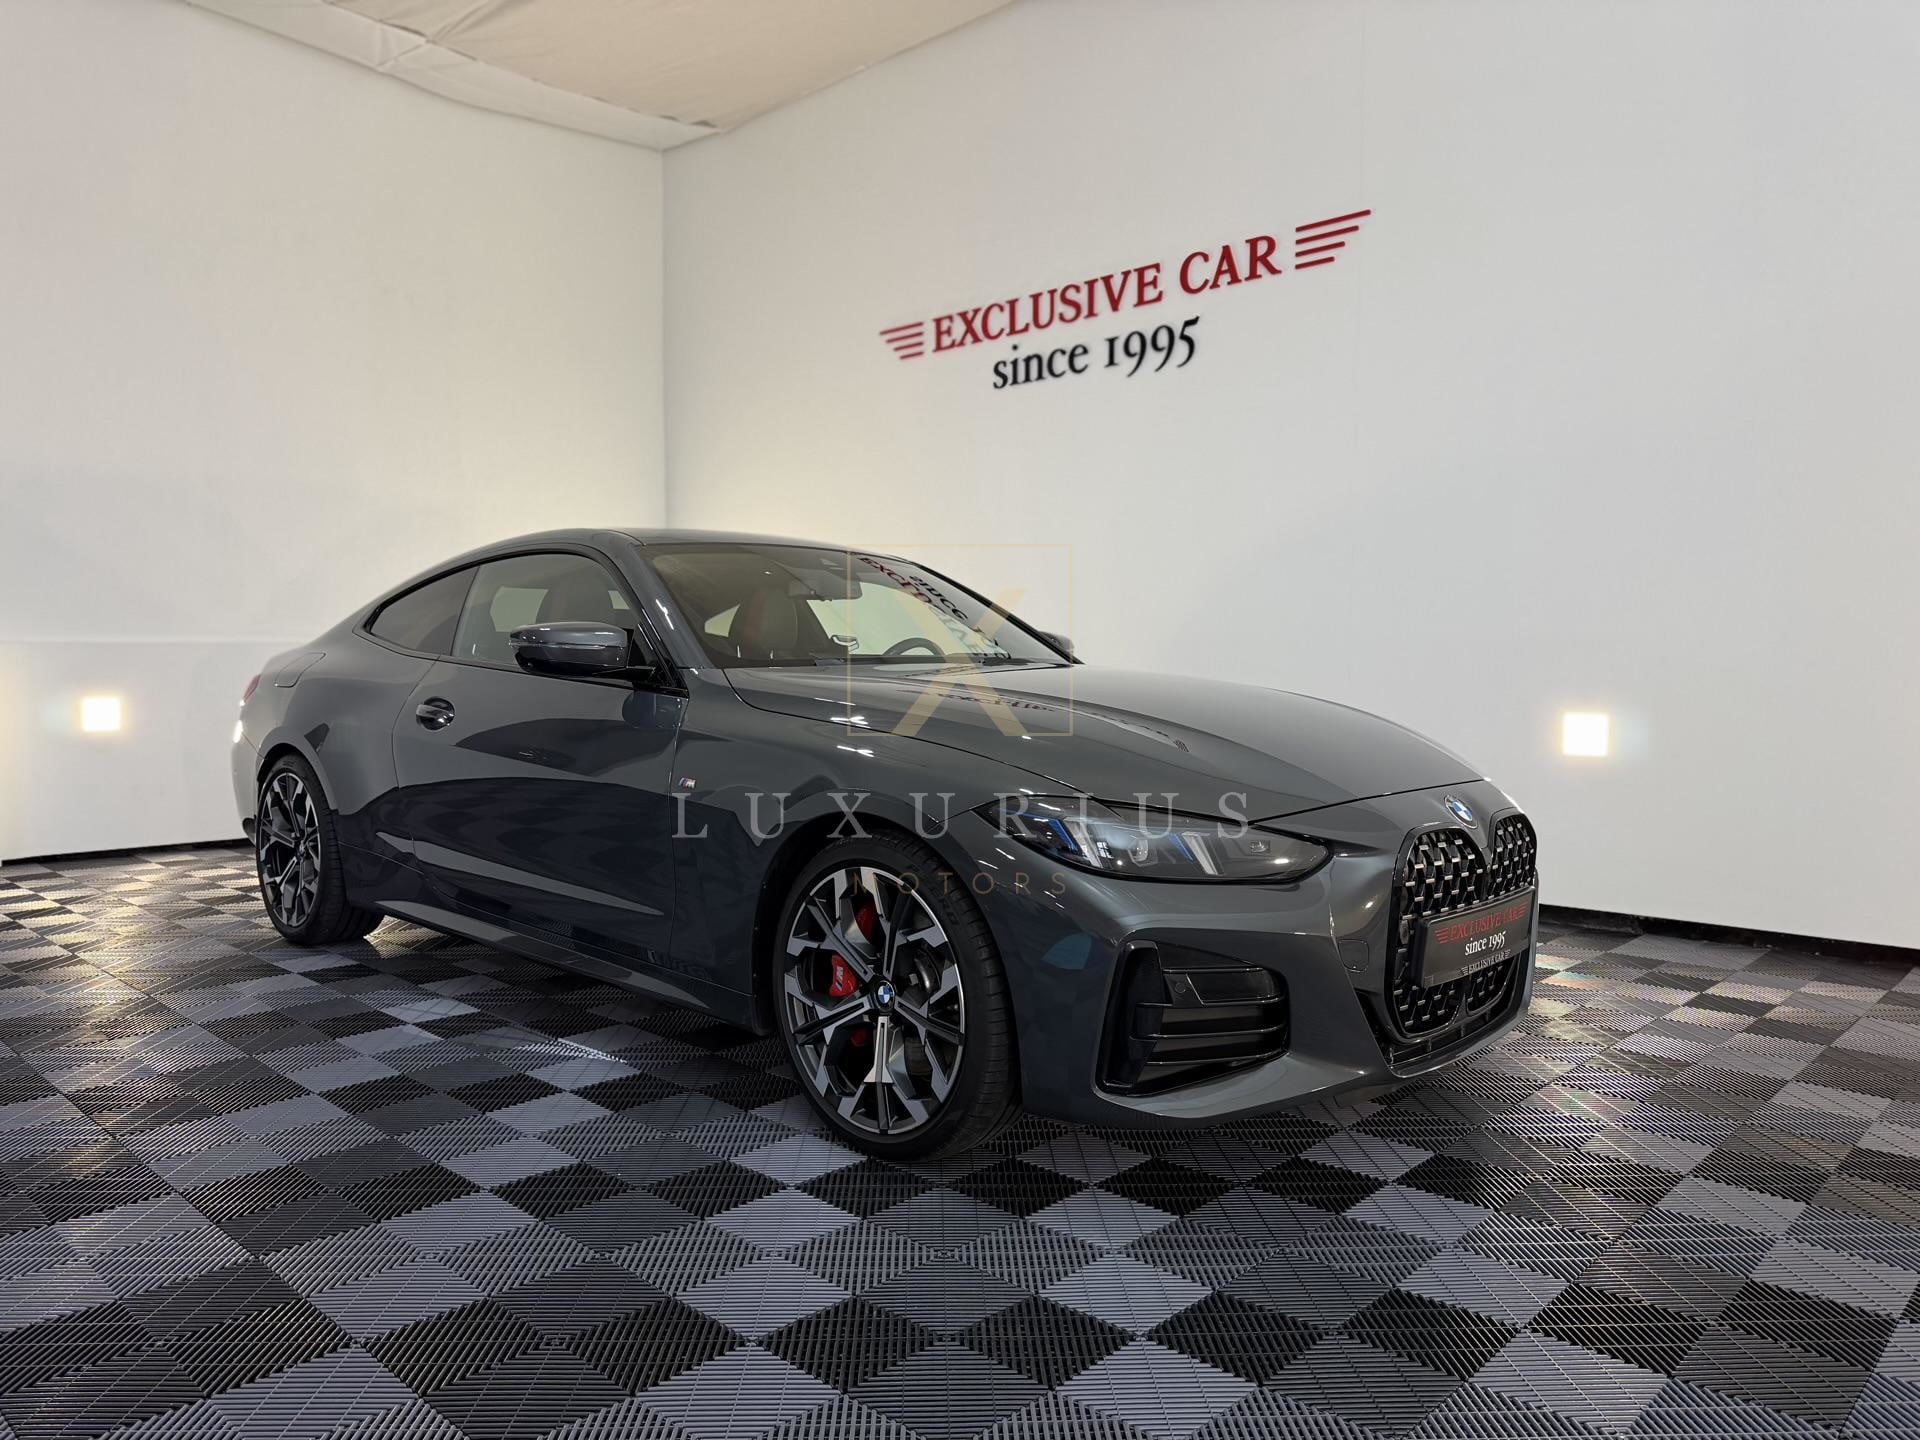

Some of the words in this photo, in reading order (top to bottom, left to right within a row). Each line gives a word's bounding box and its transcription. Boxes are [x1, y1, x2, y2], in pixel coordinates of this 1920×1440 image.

[931, 262, 1164, 353] EXCLUSIVE
[1179, 235, 1283, 294] CAR
[993, 343, 1089, 389] since
[1104, 315, 1200, 378] 1995
[1450, 912, 1501, 940] EXCLUSIVE
[1464, 937, 1487, 956] since
[1488, 930, 1507, 951] 1995
